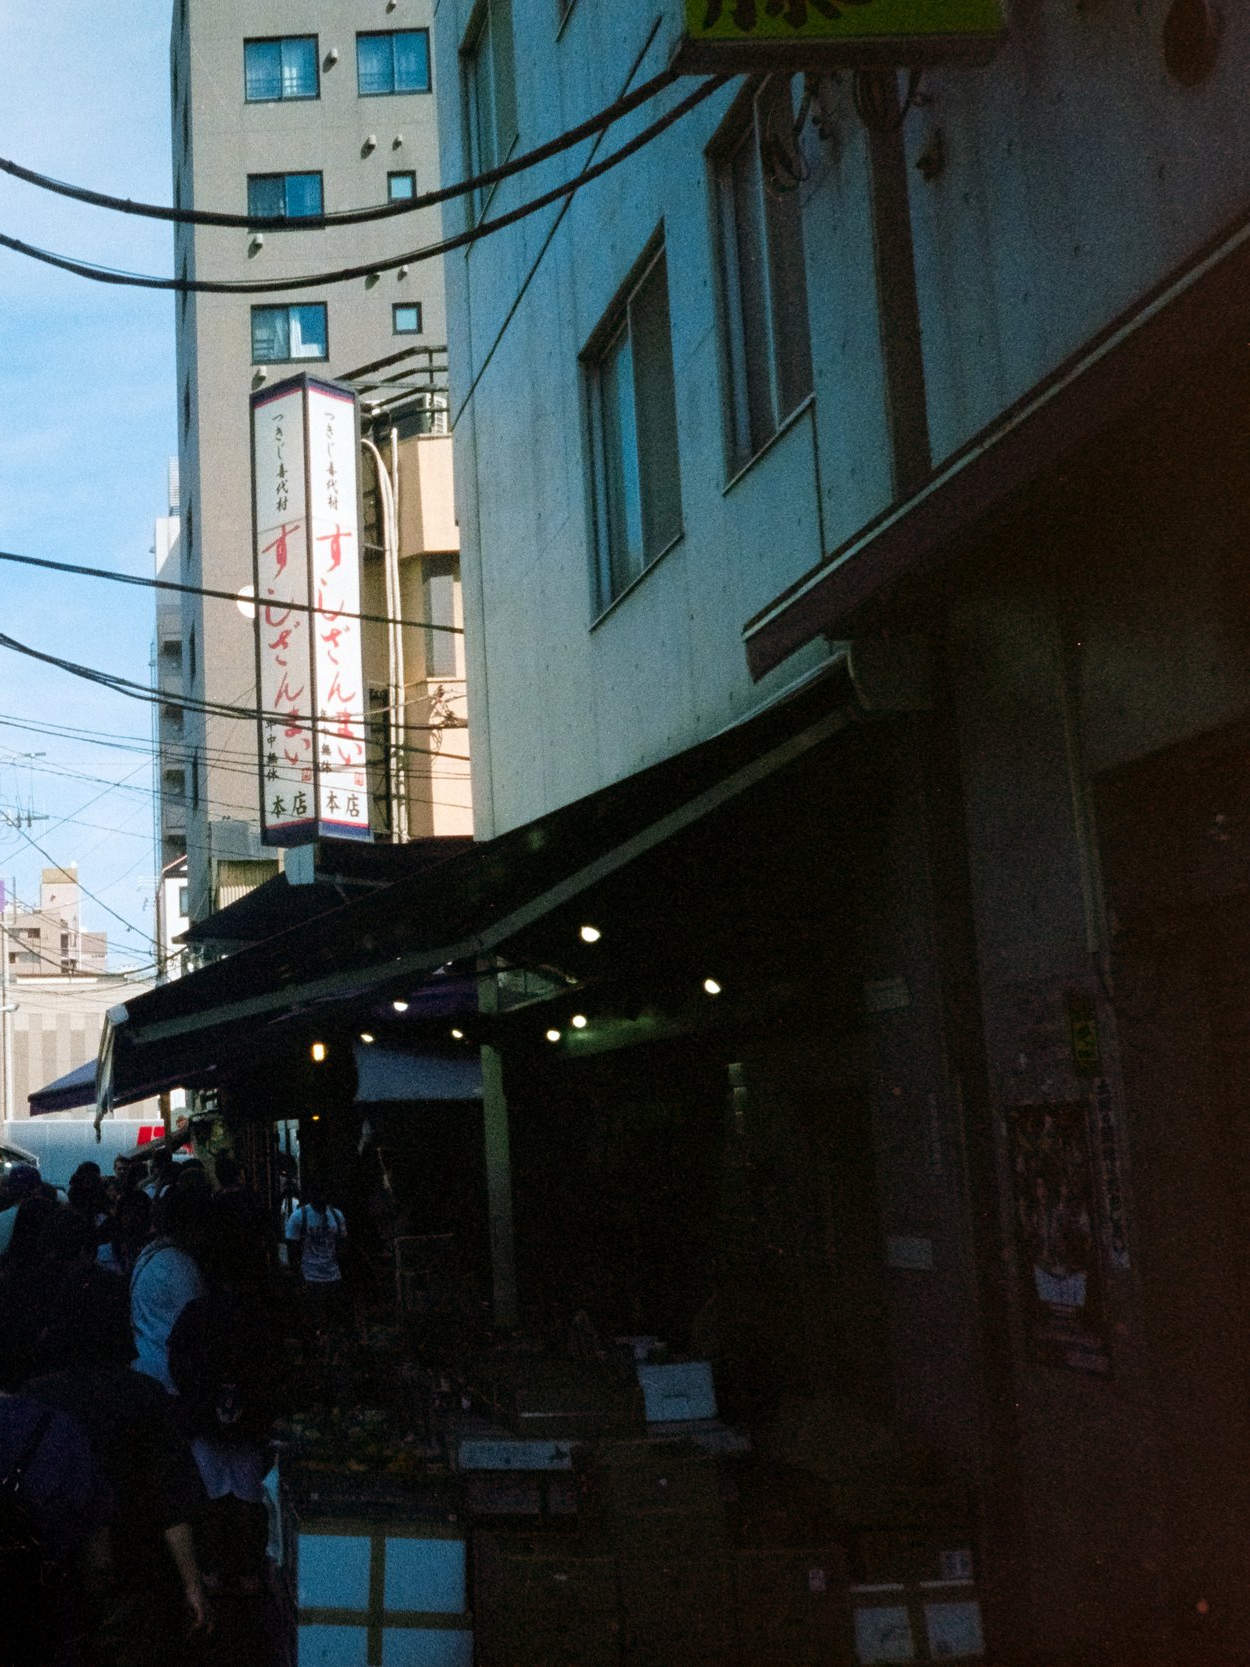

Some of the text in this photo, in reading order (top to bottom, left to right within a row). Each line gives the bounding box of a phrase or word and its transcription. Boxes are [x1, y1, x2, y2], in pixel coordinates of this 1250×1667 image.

[272, 413, 289, 513] つきじ喜代村
[324, 412, 339, 512] つきじ喜代村
[261, 523, 312, 766] すしざんまい
[316, 523, 363, 766] すしざんまい
[271, 790, 308, 819] 本店
[325, 790, 360, 818] 本店
